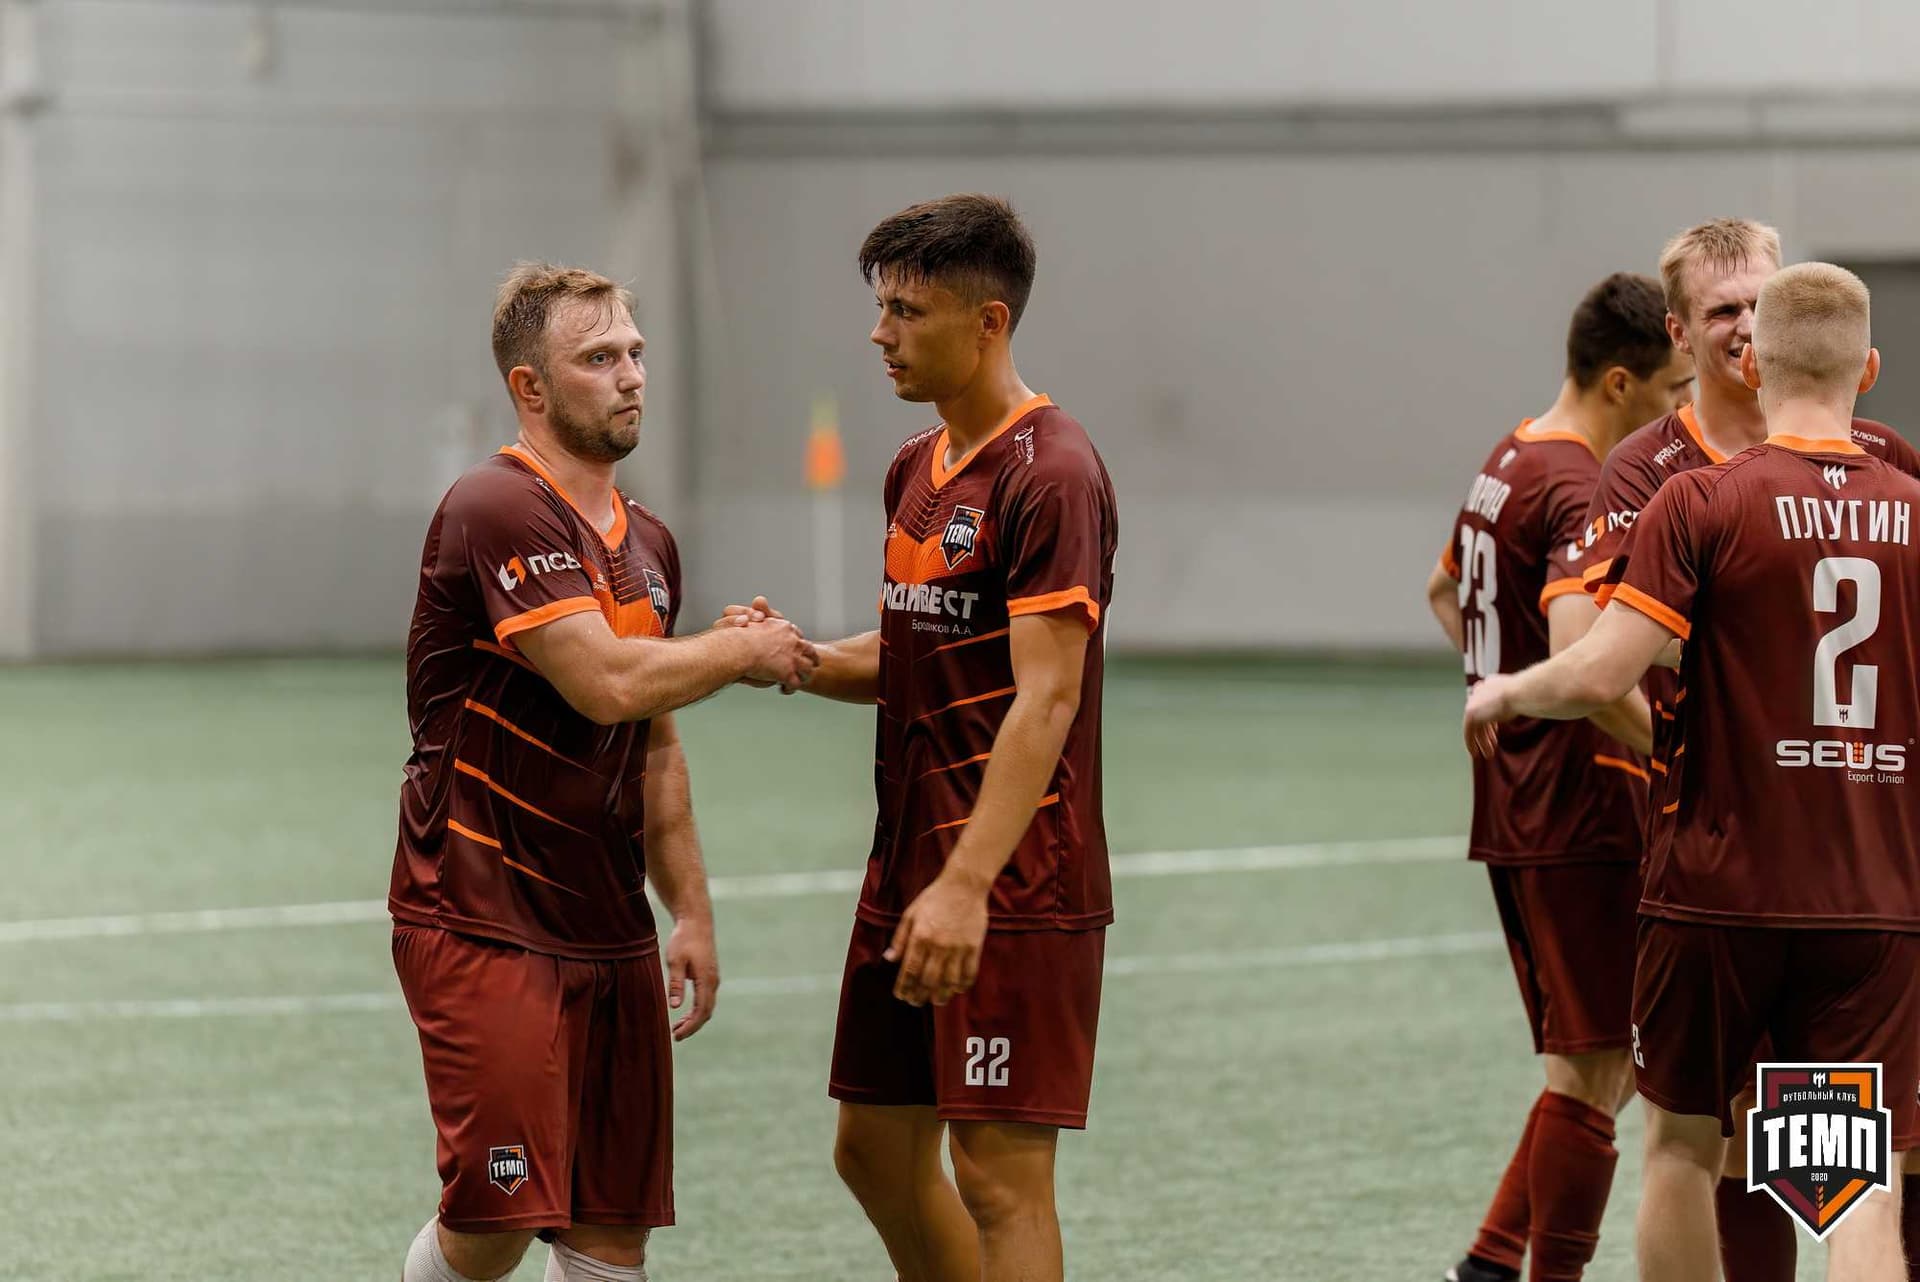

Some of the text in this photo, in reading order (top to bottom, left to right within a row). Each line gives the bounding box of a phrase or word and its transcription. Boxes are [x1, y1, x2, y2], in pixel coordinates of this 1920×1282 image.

[945, 524, 975, 548] ТЕМП
[1775, 496, 1910, 545] ПЛУГИН
[1813, 557, 1881, 729] 2
[1776, 740, 1906, 772] SEUS
[1847, 770, 1905, 785] Export Union
[965, 1036, 1010, 1087] 22
[492, 1159, 524, 1179] ТЕМП
